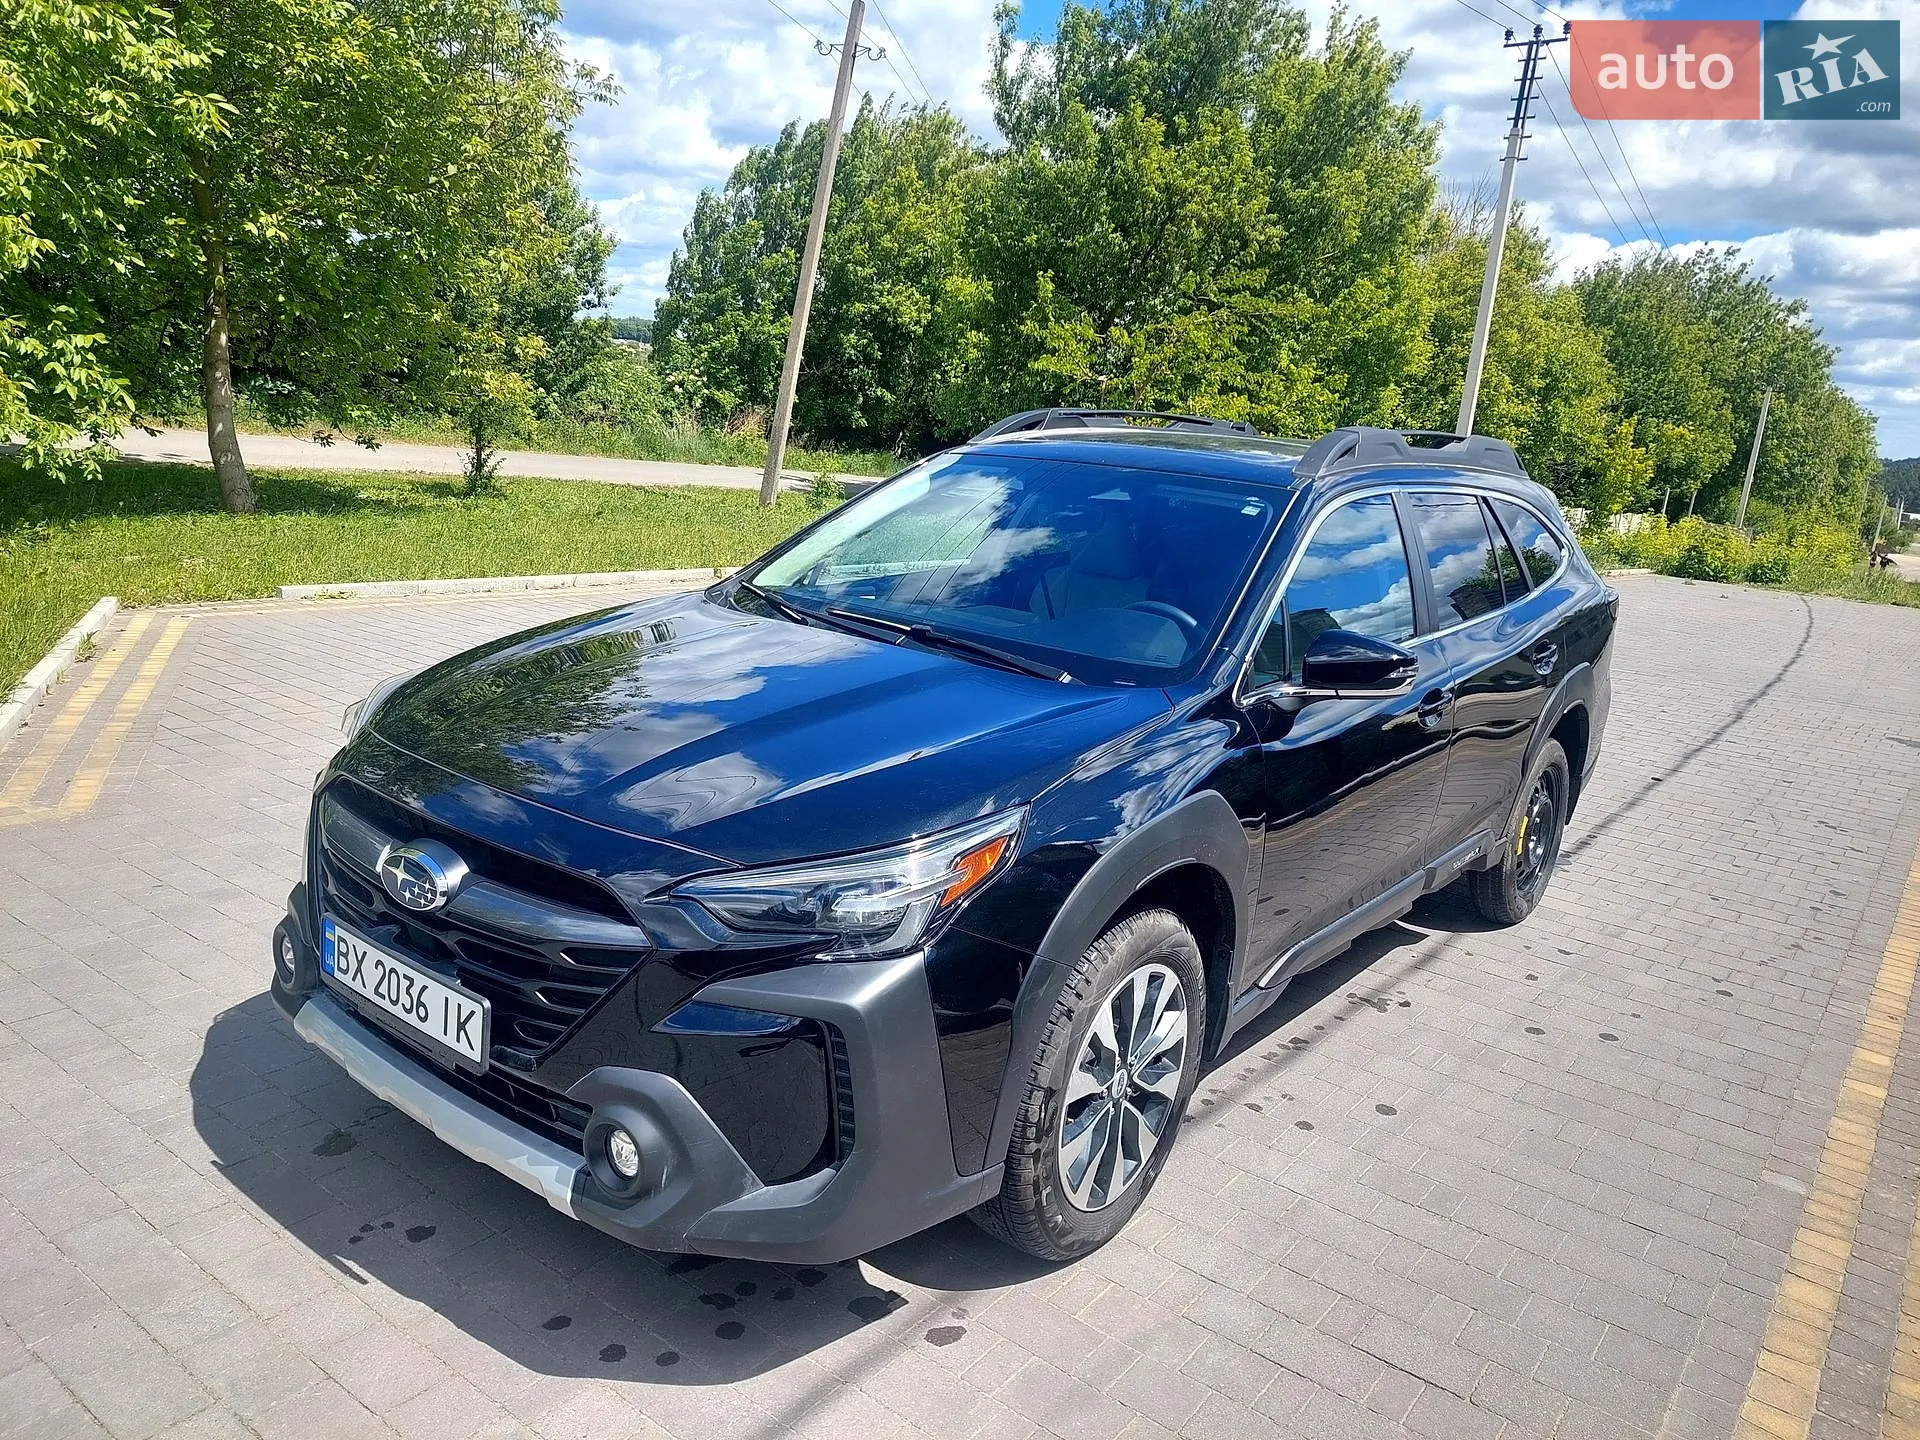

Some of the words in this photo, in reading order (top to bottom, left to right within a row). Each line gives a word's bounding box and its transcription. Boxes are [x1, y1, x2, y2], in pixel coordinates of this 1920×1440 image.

[325, 952, 335, 968] UA
[336, 934, 367, 989] BX
[373, 958, 429, 1023] 2036
[442, 996, 476, 1051] IK
